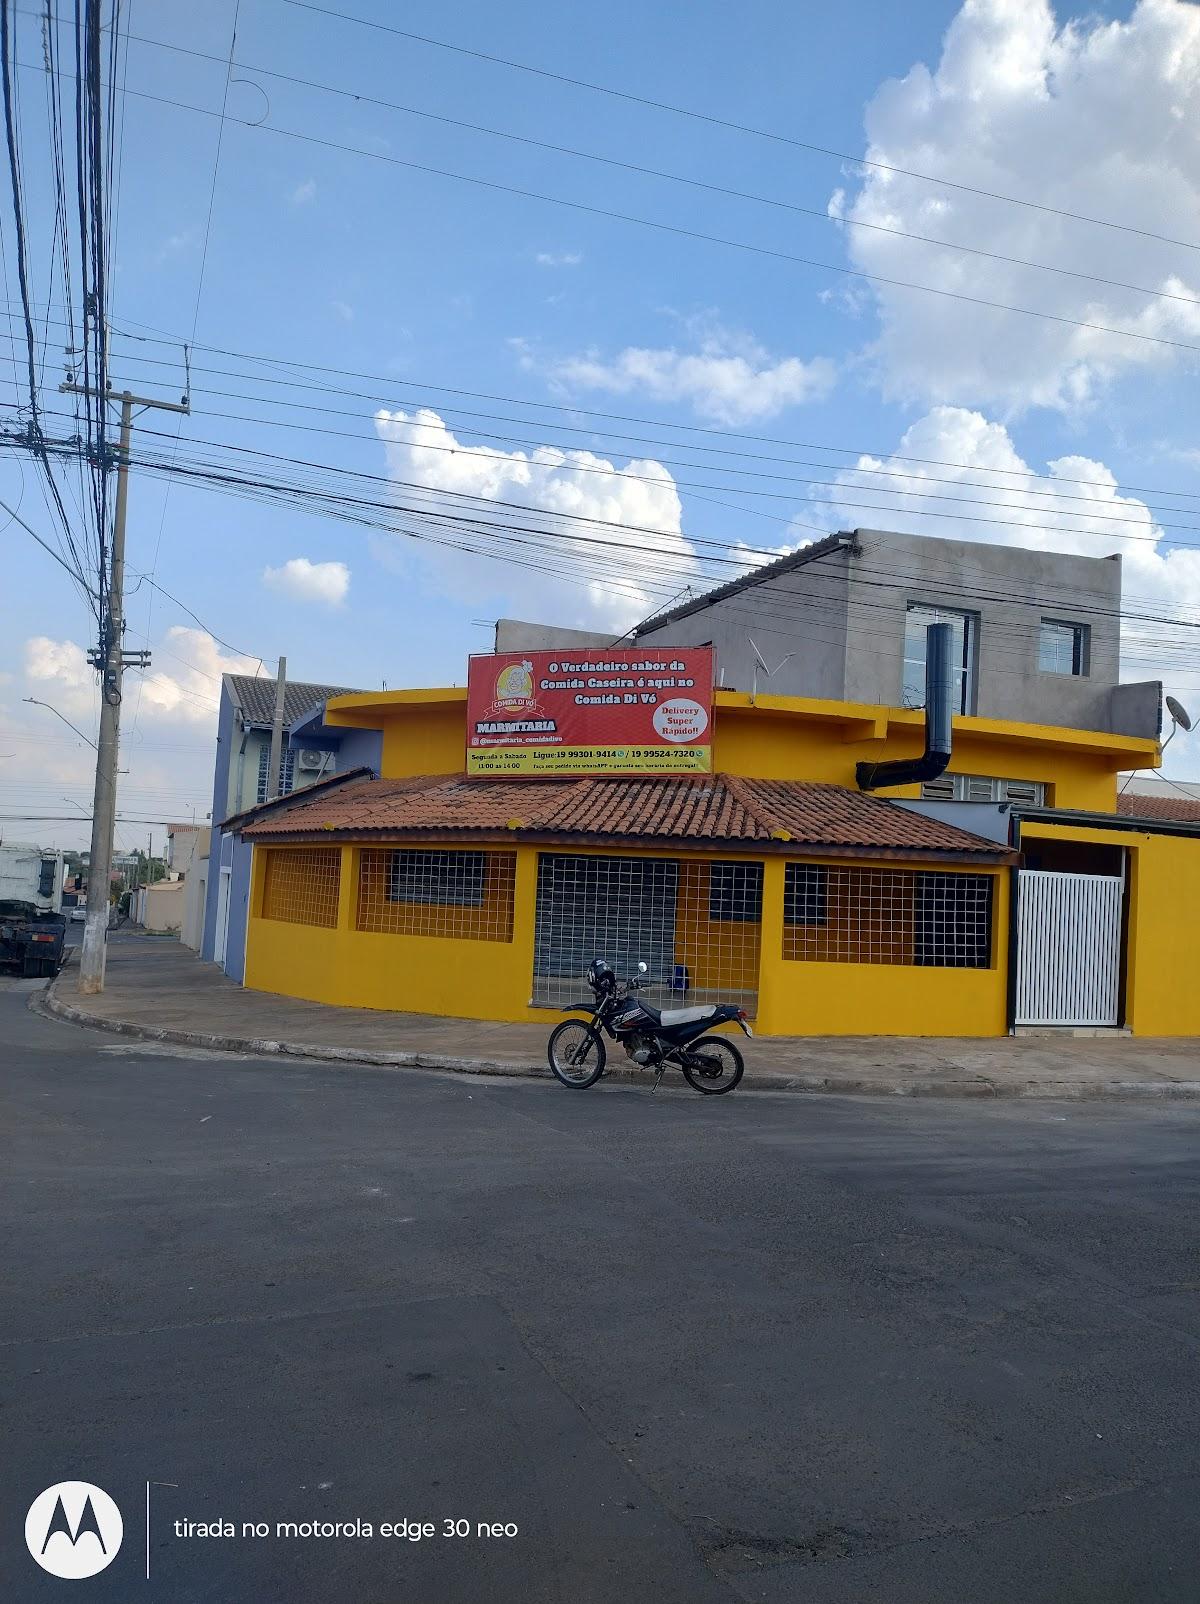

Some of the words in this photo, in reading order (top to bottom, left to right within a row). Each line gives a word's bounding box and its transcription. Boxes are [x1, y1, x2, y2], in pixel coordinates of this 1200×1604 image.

[549, 663, 559, 673] O
[561, 661, 628, 673] Verdadeiro
[631, 660, 667, 672] sabor
[669, 660, 685, 671] da
[540, 678, 585, 690] Comida
[587, 677, 635, 689] Caseira
[637, 676, 645, 687] é
[647, 677, 676, 689] aqui
[677, 679, 694, 687] no
[494, 698, 517, 708] COMIDA
[575, 693, 621, 705] Comida
[623, 693, 638, 704] Di
[641, 693, 657, 704] Vó
[662, 706, 699, 715] Delivery
[667, 717, 693, 725] Super
[476, 720, 556, 733] MARMITARIA
[471, 753, 498, 761] Segunda
[568, 750, 617, 758] 99301-9414
[631, 750, 642, 758] 19
[643, 750, 695, 758] 99524-7320
